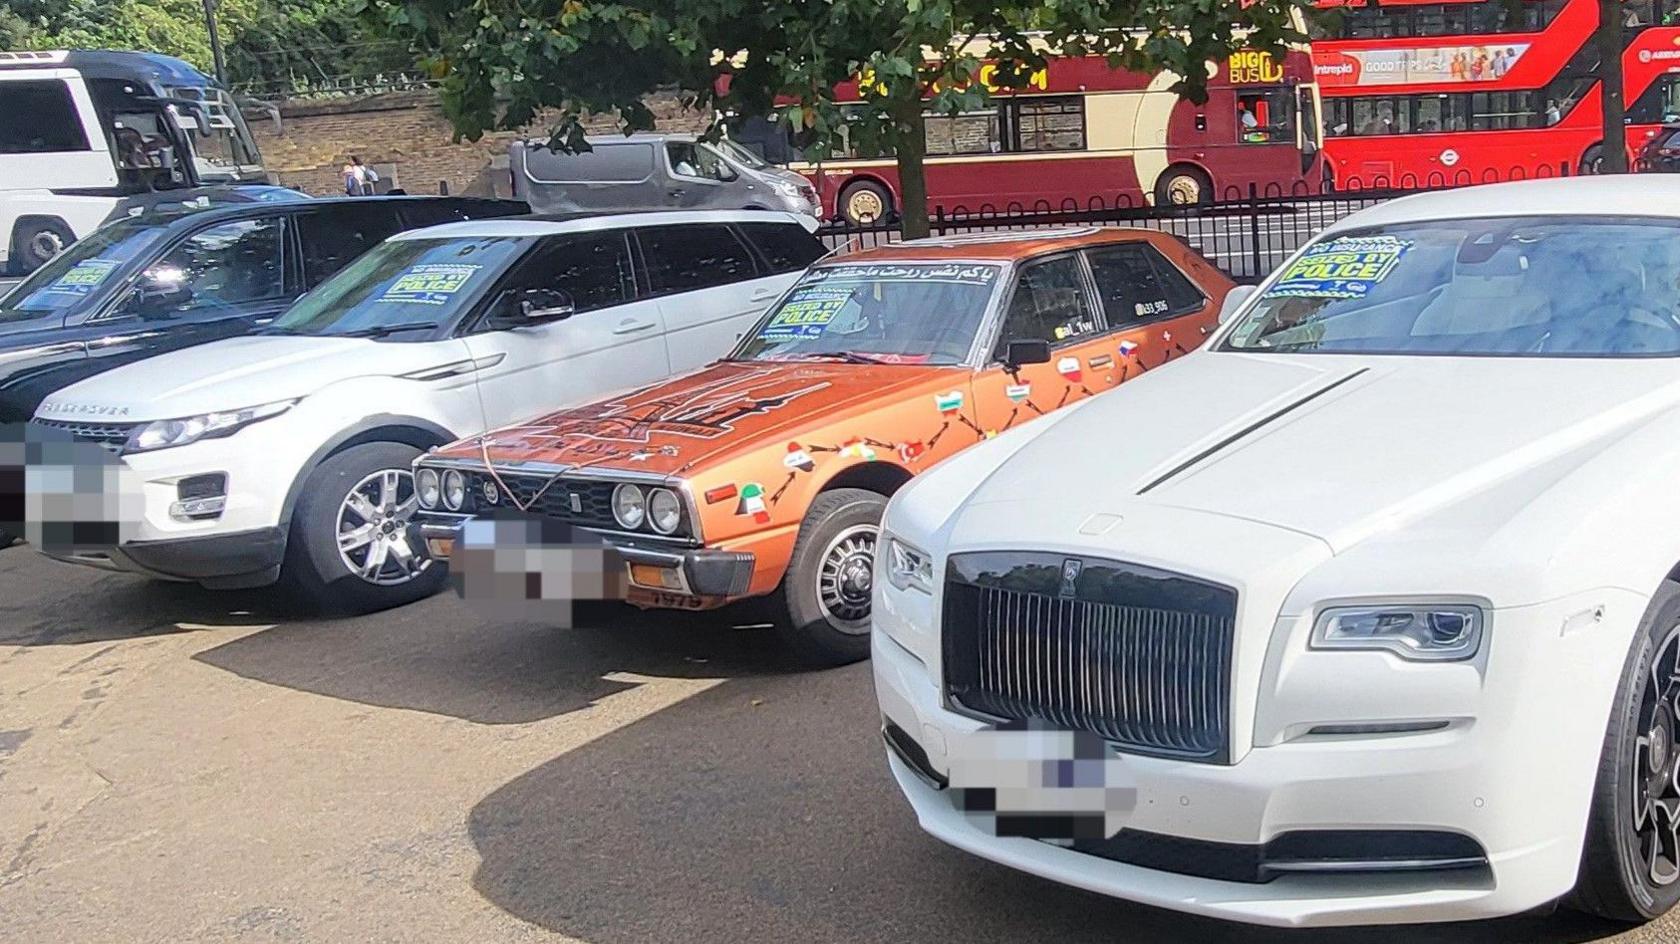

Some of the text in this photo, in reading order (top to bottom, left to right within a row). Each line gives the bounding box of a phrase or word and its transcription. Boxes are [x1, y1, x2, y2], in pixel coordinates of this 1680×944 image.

[1229, 52, 1259, 69] BIG
[1365, 61, 1394, 72] GOOD
[1230, 68, 1259, 83] BUS
[1313, 63, 1353, 76] Intrepid
[1297, 252, 1391, 266] SEIZED BY
[1286, 262, 1383, 280] POLICE
[393, 280, 459, 291] POLICE
[776, 309, 835, 324] POLICE
